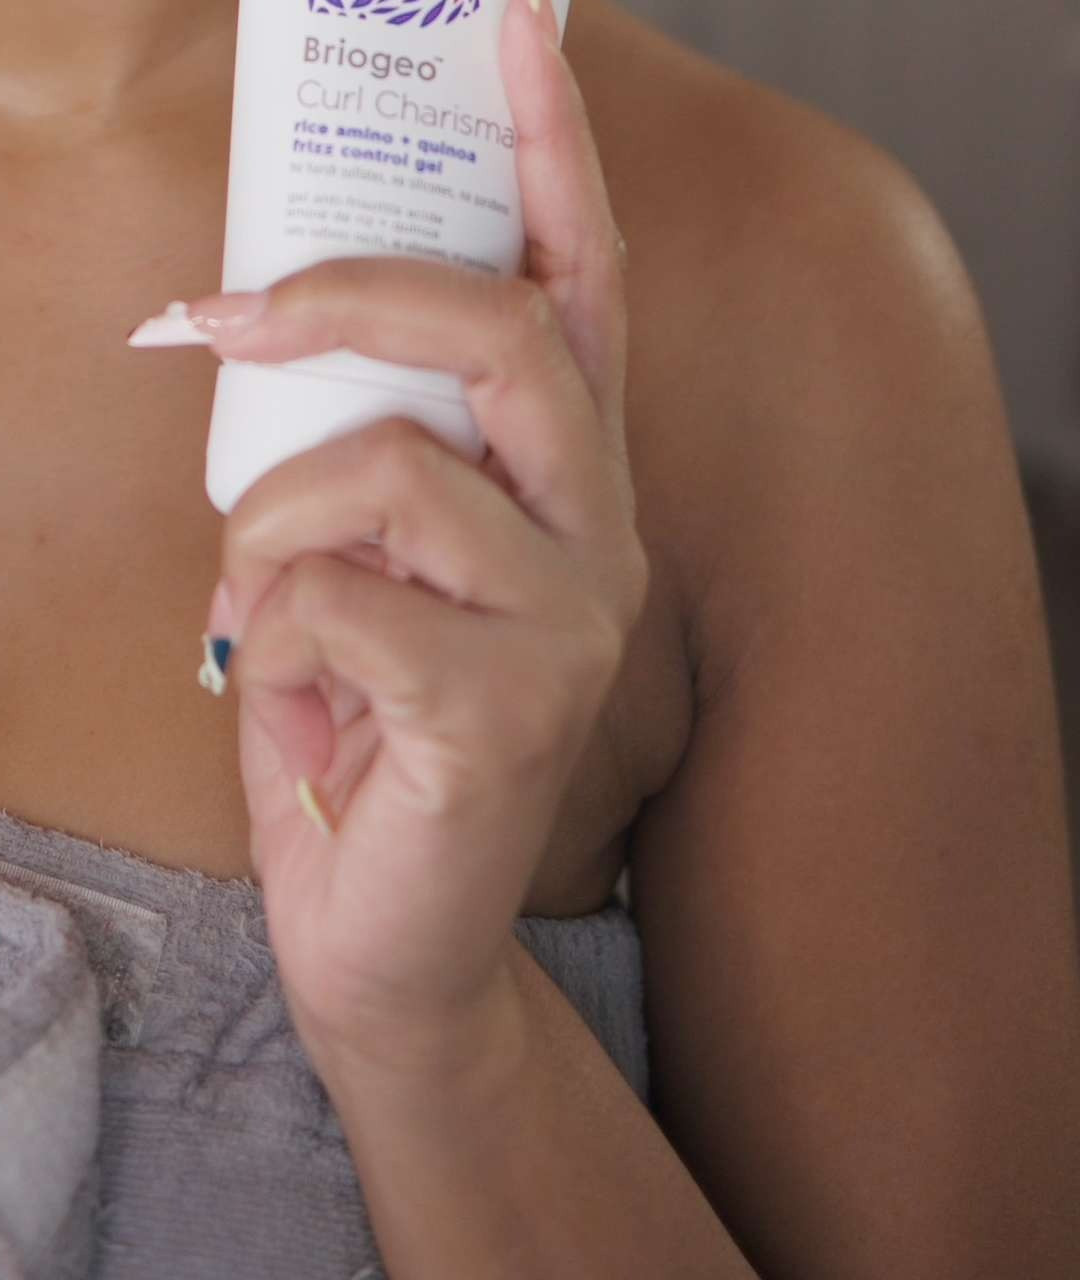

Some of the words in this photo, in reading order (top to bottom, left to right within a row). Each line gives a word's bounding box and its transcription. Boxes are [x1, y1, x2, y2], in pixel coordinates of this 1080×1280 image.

[296, 79, 363, 113] Curl
[374, 90, 515, 150] Charisma
[292, 139, 334, 157] frizz
[340, 142, 409, 167] control
[414, 155, 443, 174] gel
[293, 119, 329, 135] rice
[335, 124, 394, 145] amino
[416, 138, 477, 164] quinoa
